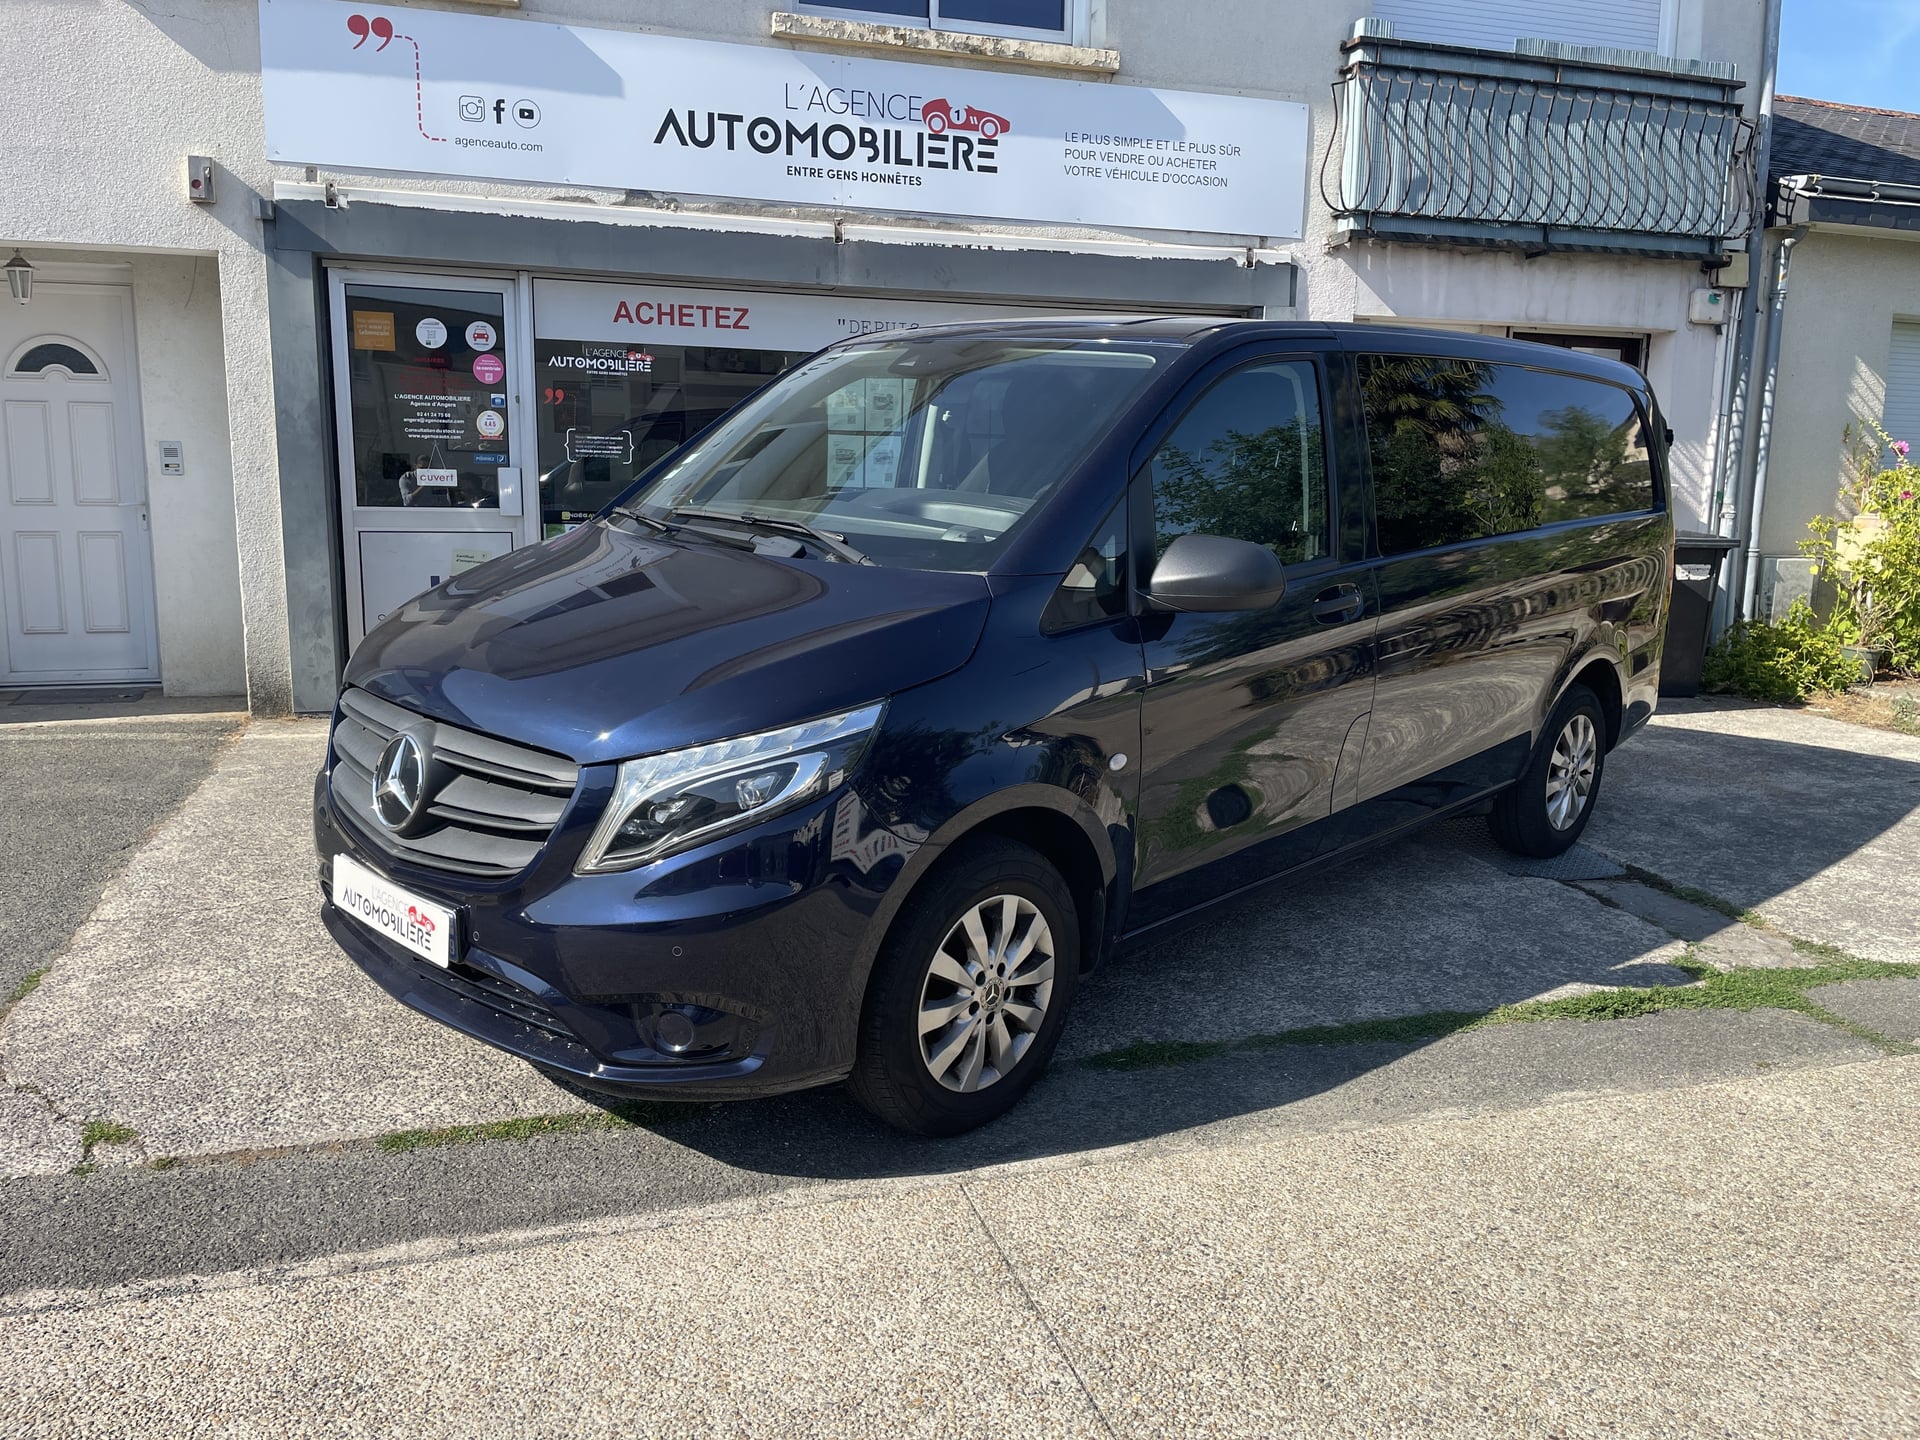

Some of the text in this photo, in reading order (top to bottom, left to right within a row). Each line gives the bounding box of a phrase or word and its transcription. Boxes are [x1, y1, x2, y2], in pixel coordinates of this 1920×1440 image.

[785, 82, 922, 122] L'AGENCE
[455, 136, 543, 152] agenceauto.com
[1064, 131, 1241, 156] LE PLUS SIMPLE ET LE PLUS SÛR
[1064, 148, 1217, 171] POUR VENDRE OU ACHETER
[786, 165, 922, 186] ENTRE GENS HONNÊTES
[1064, 165, 1228, 187] VOTRE VÉHICULE D'OCCASION
[613, 300, 750, 330] ACHETEZ
[585, 347, 628, 359] L'AGENCE
[424, 394, 471, 402] AUTOMOBILIERE
[432, 401, 456, 409] d'Angers
